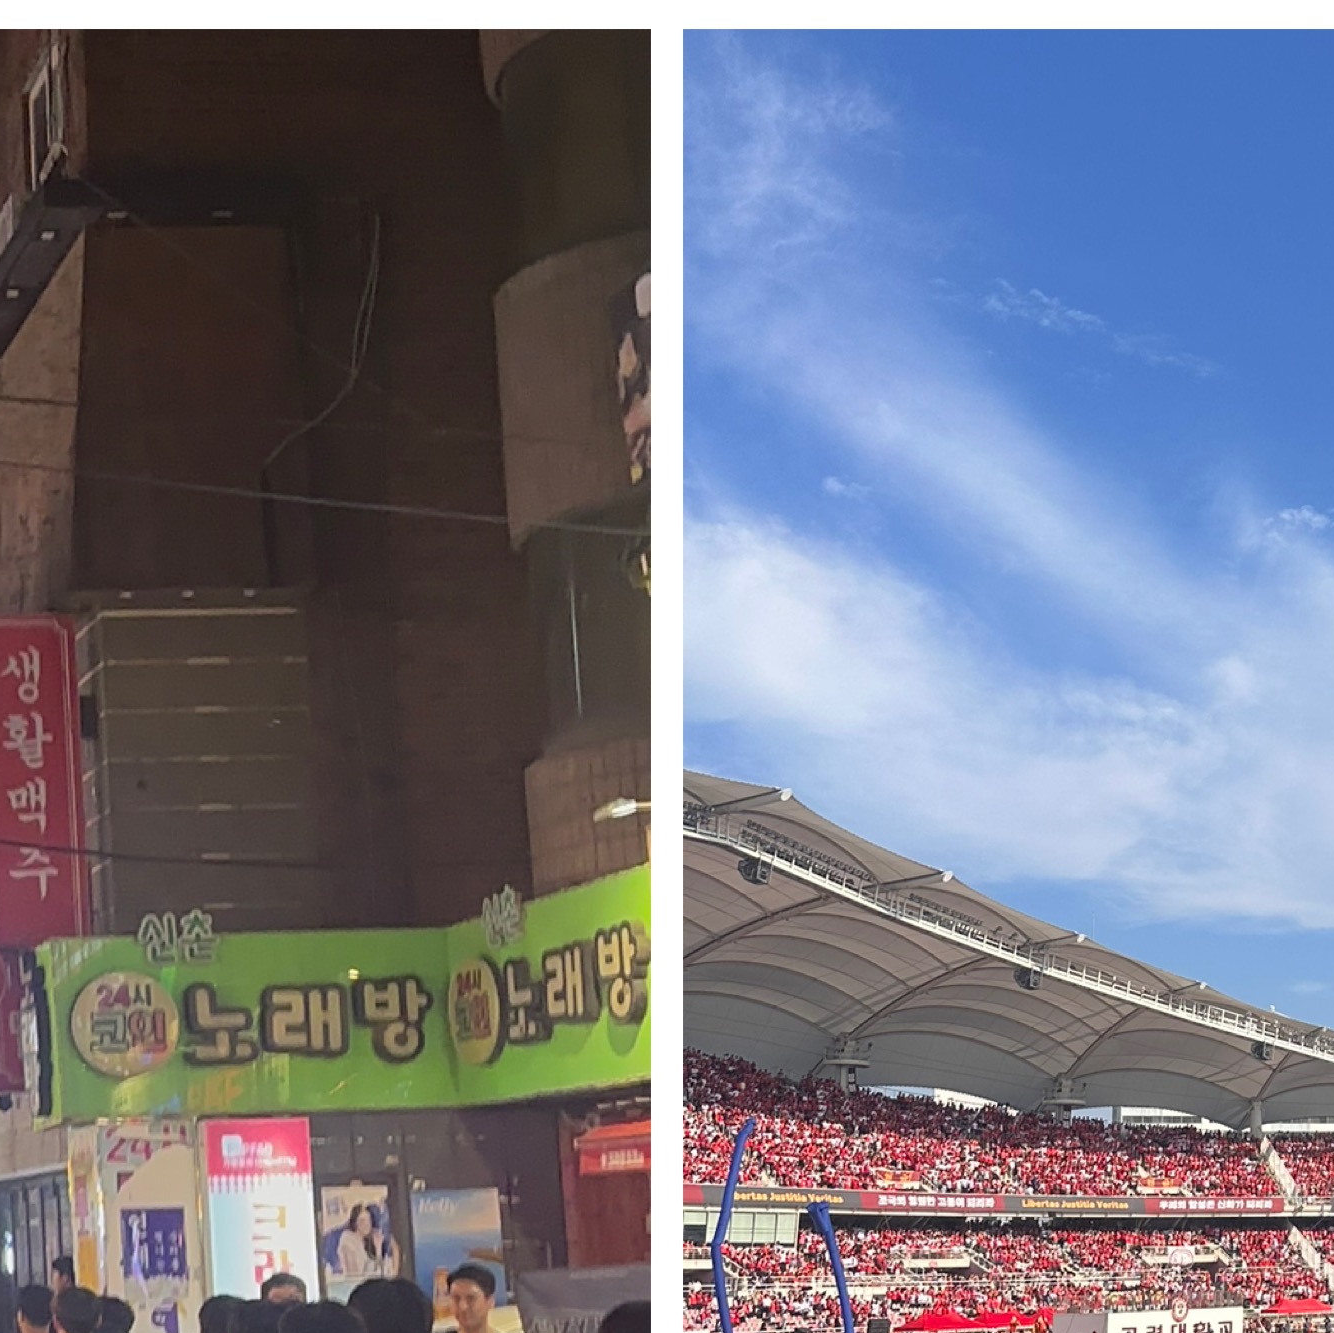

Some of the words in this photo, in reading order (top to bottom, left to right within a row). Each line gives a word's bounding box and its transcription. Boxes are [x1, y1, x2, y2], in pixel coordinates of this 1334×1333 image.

[0, 644, 59, 901] 생활맥주
[137, 908, 219, 965] 신촌
[95, 982, 152, 1008] 24시
[503, 925, 639, 1042] 노래방
[90, 1008, 168, 1054] 코인
[186, 978, 432, 1061] 노래방
[733, 1191, 768, 1201] bertas
[1021, 1199, 1060, 1208] Libertas
[1061, 1200, 1095, 1209] Justitia
[1096, 1200, 1129, 1209] Veritas
